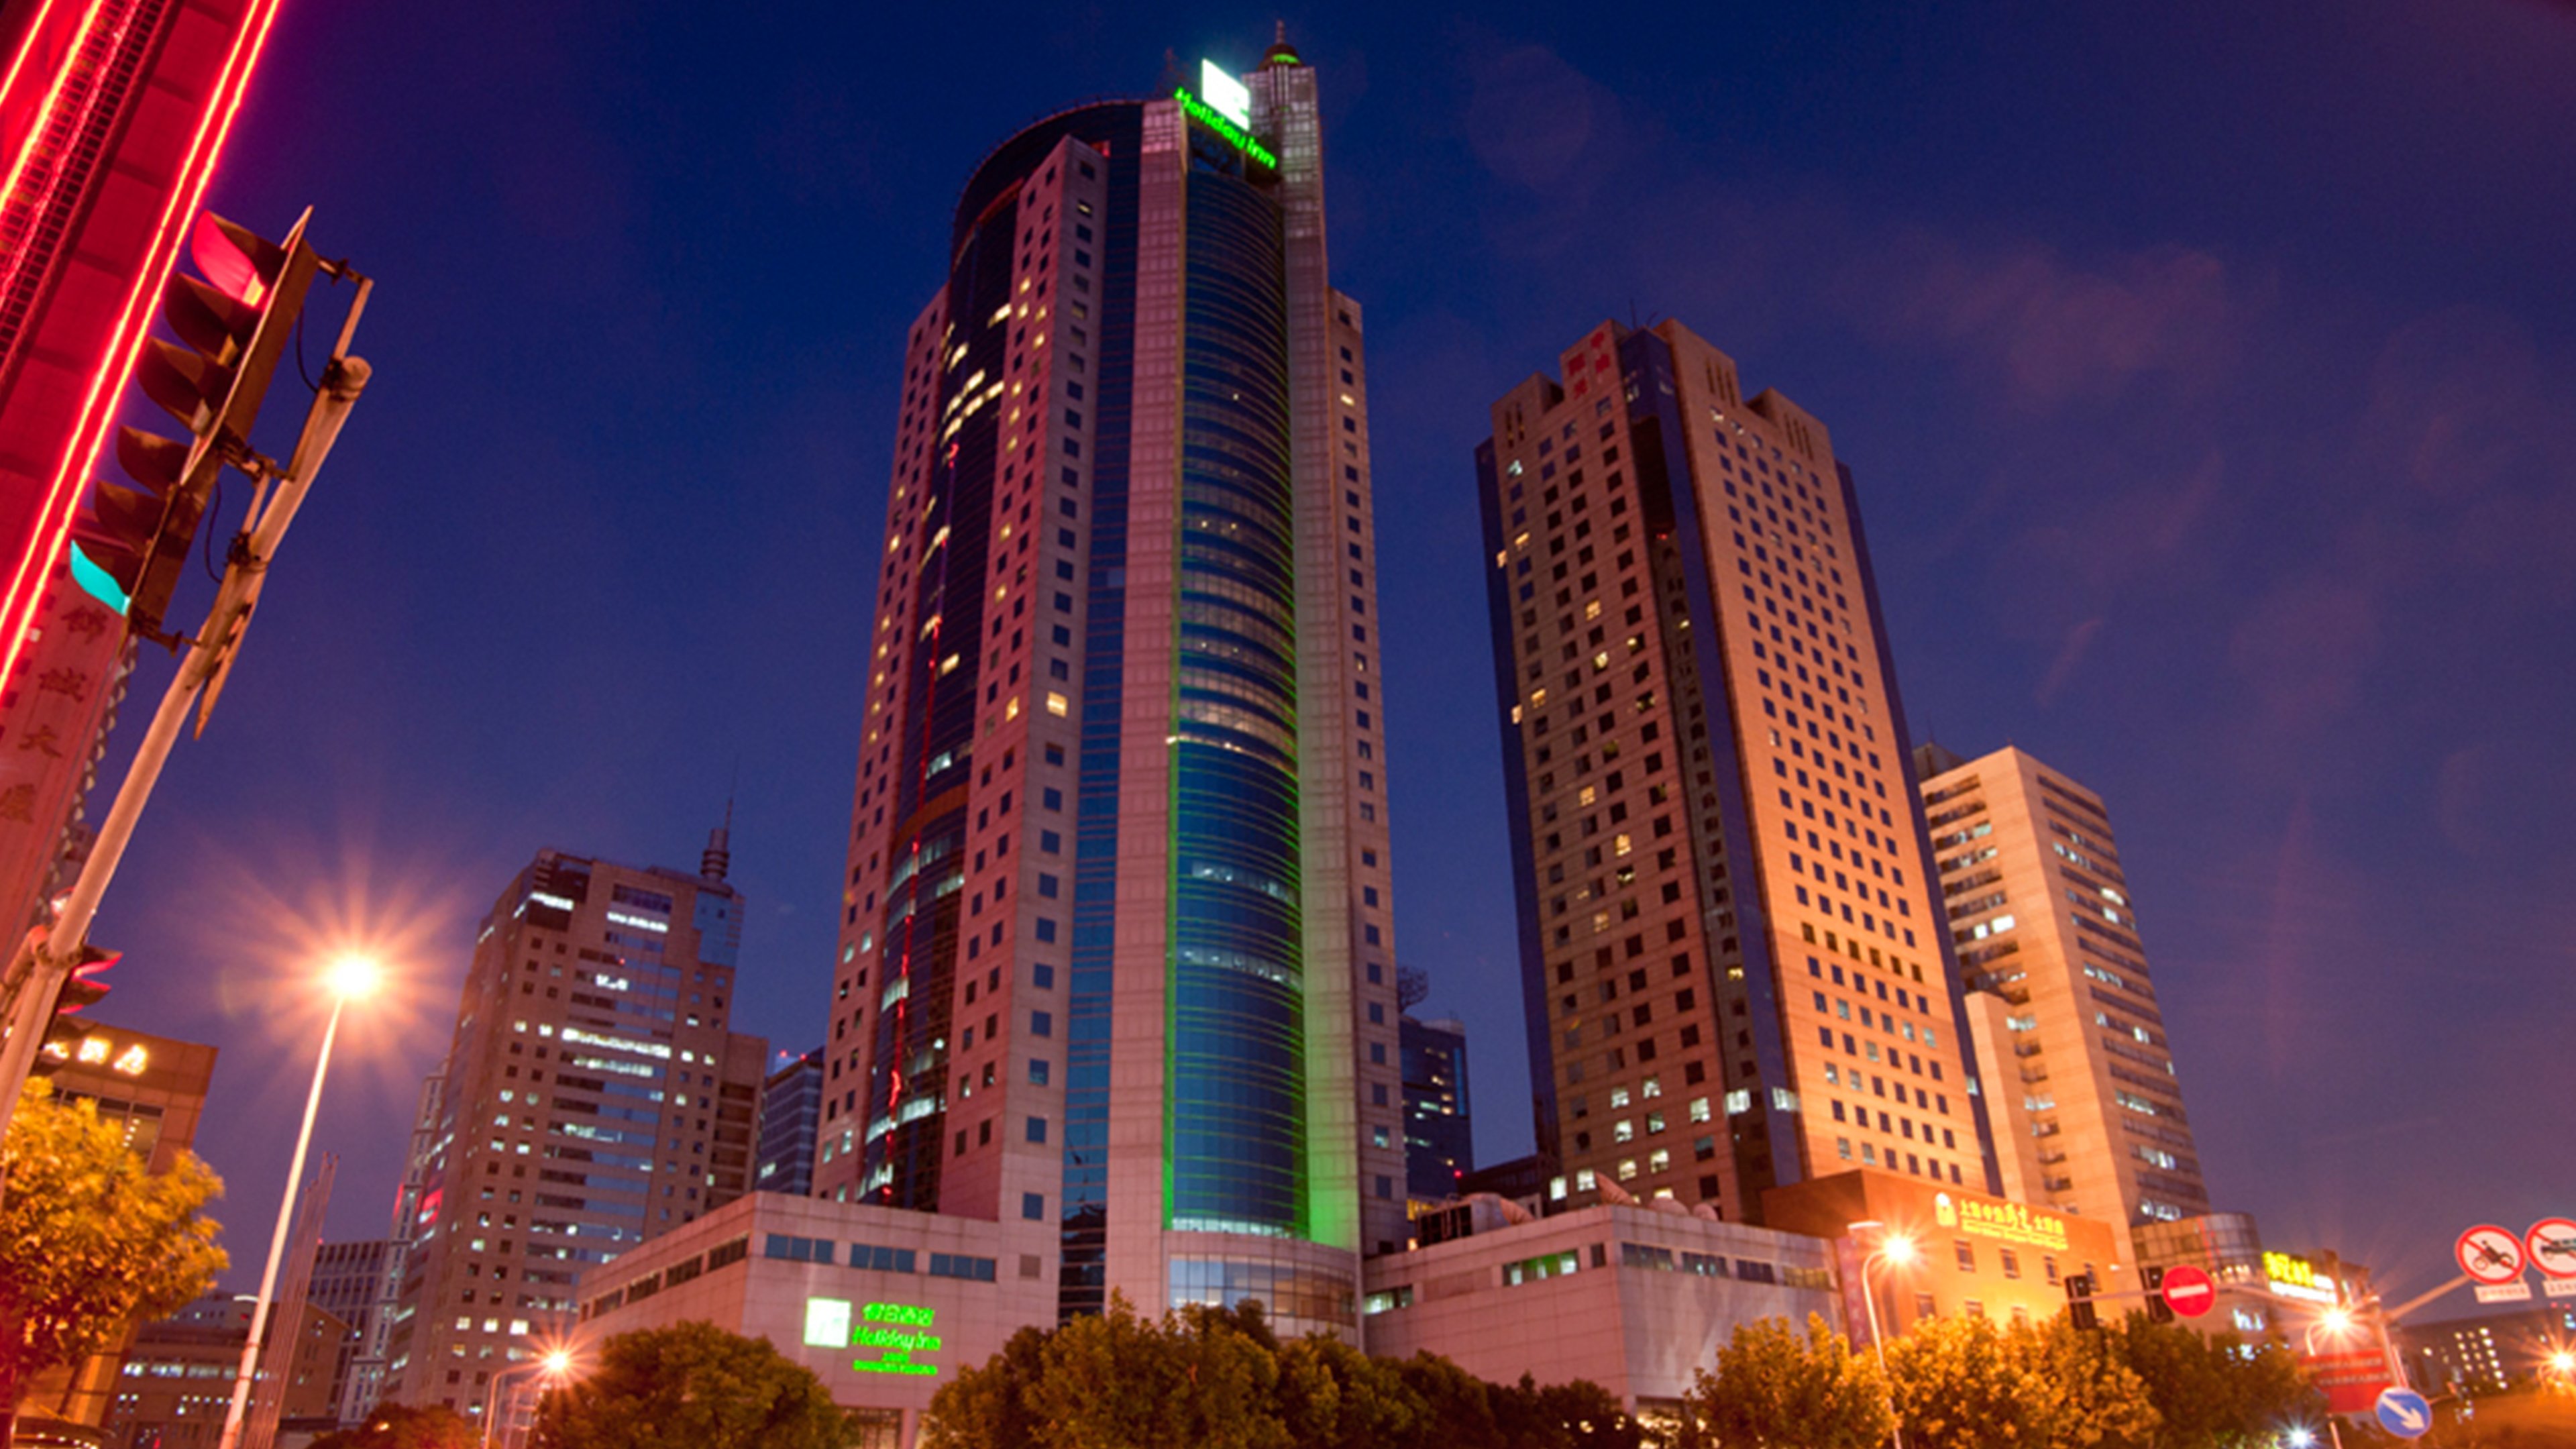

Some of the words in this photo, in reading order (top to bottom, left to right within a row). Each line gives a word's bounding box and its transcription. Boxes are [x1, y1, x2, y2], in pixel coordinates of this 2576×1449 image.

[1175, 87, 1246, 150] Holiday
[1246, 136, 1276, 168] Inn
[852, 1325, 915, 1352] Holiday
[916, 1330, 941, 1351] Inn
